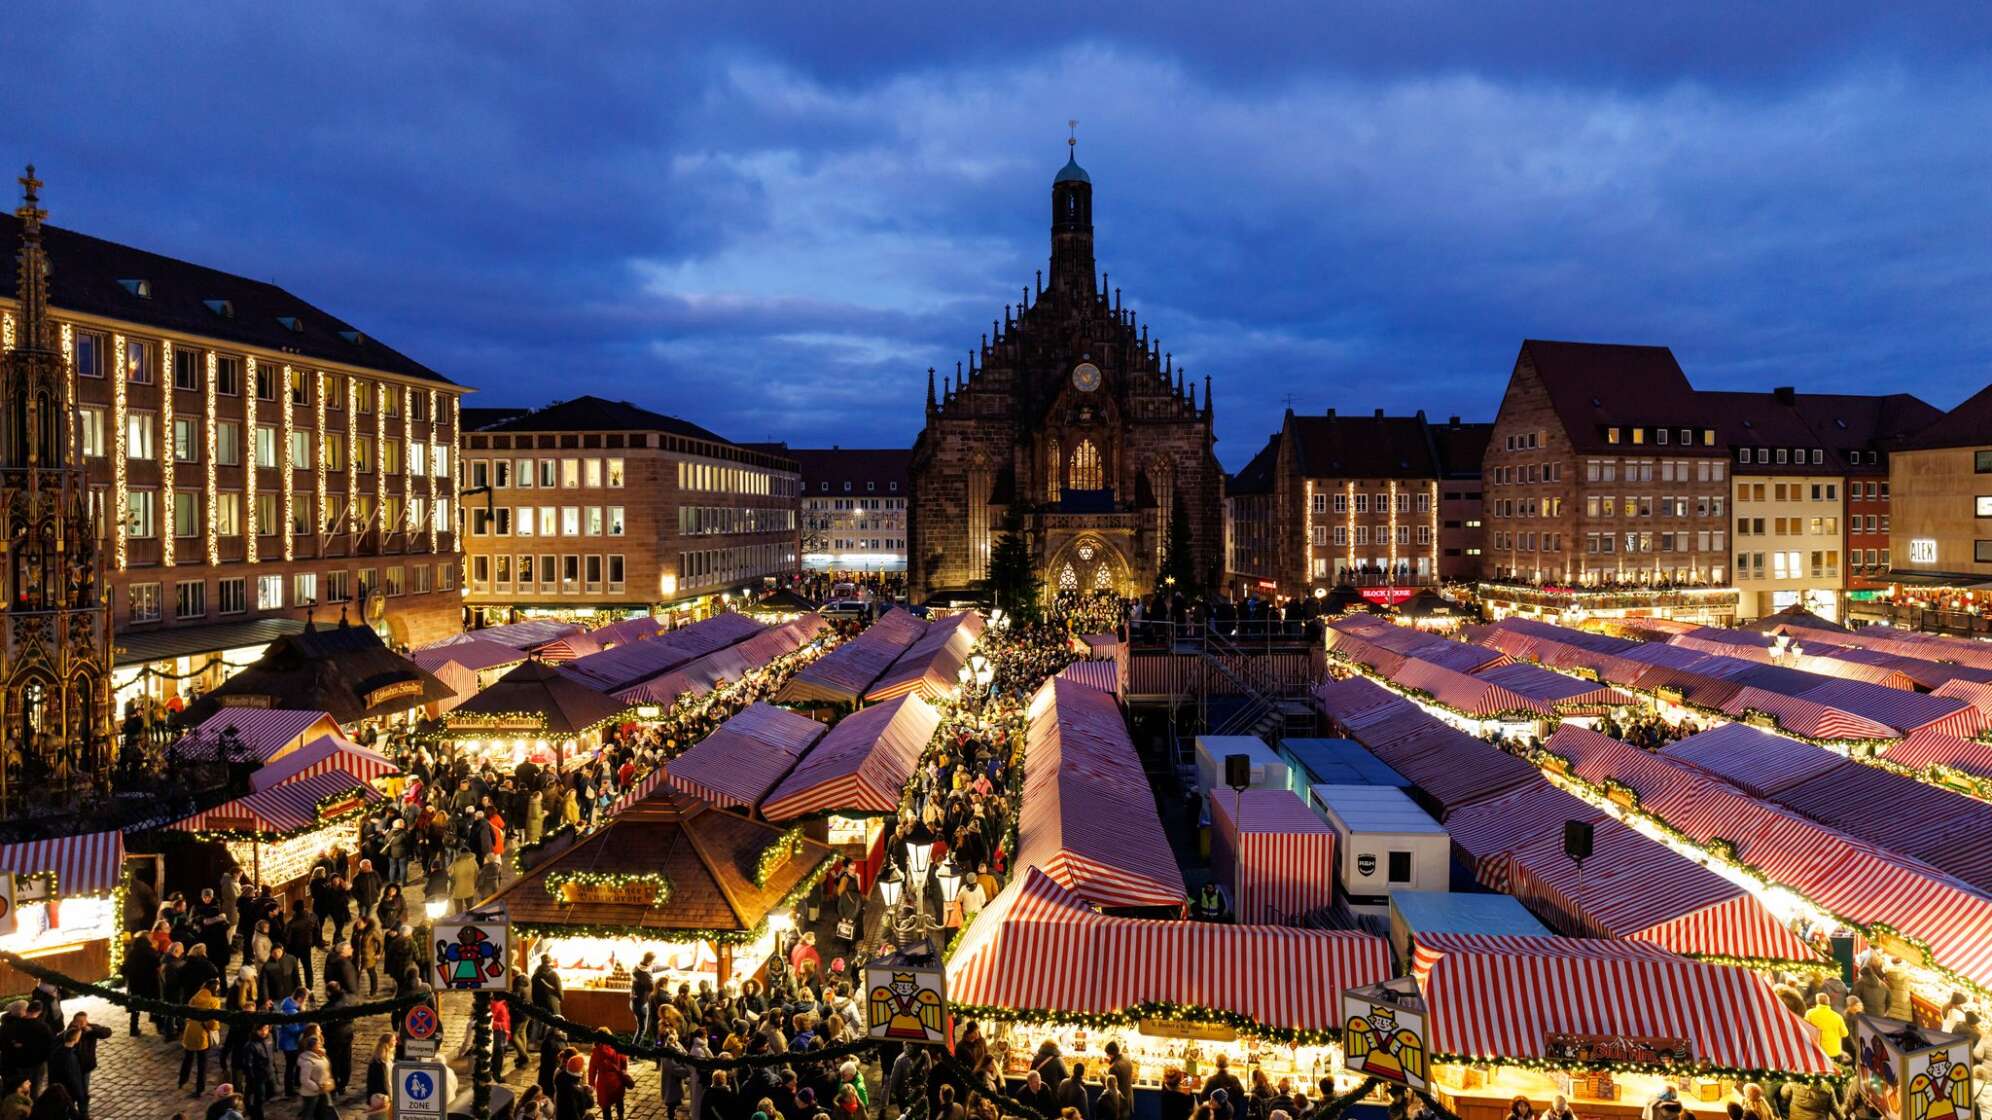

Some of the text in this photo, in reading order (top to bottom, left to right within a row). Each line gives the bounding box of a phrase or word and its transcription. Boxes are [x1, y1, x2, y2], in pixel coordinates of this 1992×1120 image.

[1910, 540, 1935, 562] ALEX
[1362, 590, 1386, 598] BLOCK
[408, 1101, 430, 1109] ZONE
